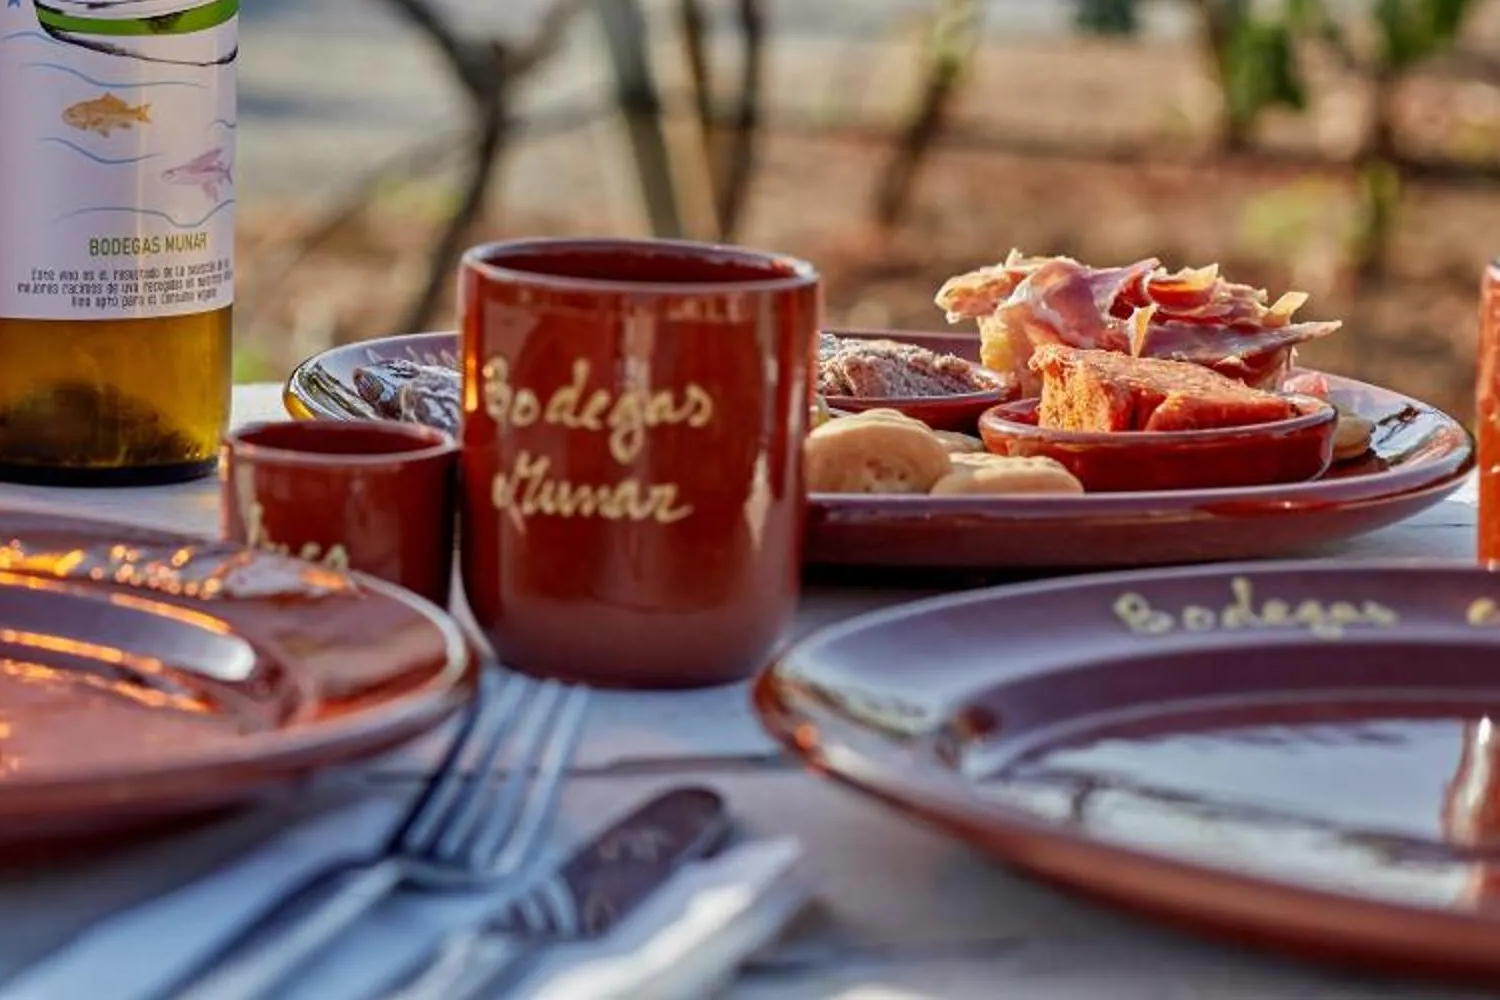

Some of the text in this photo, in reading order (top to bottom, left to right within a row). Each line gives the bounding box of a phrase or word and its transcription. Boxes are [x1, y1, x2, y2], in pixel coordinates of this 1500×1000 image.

[89, 232, 207, 256] BODEGAS MUNAR
[481, 356, 713, 466] Bodegas
[492, 450, 695, 535] Munar
